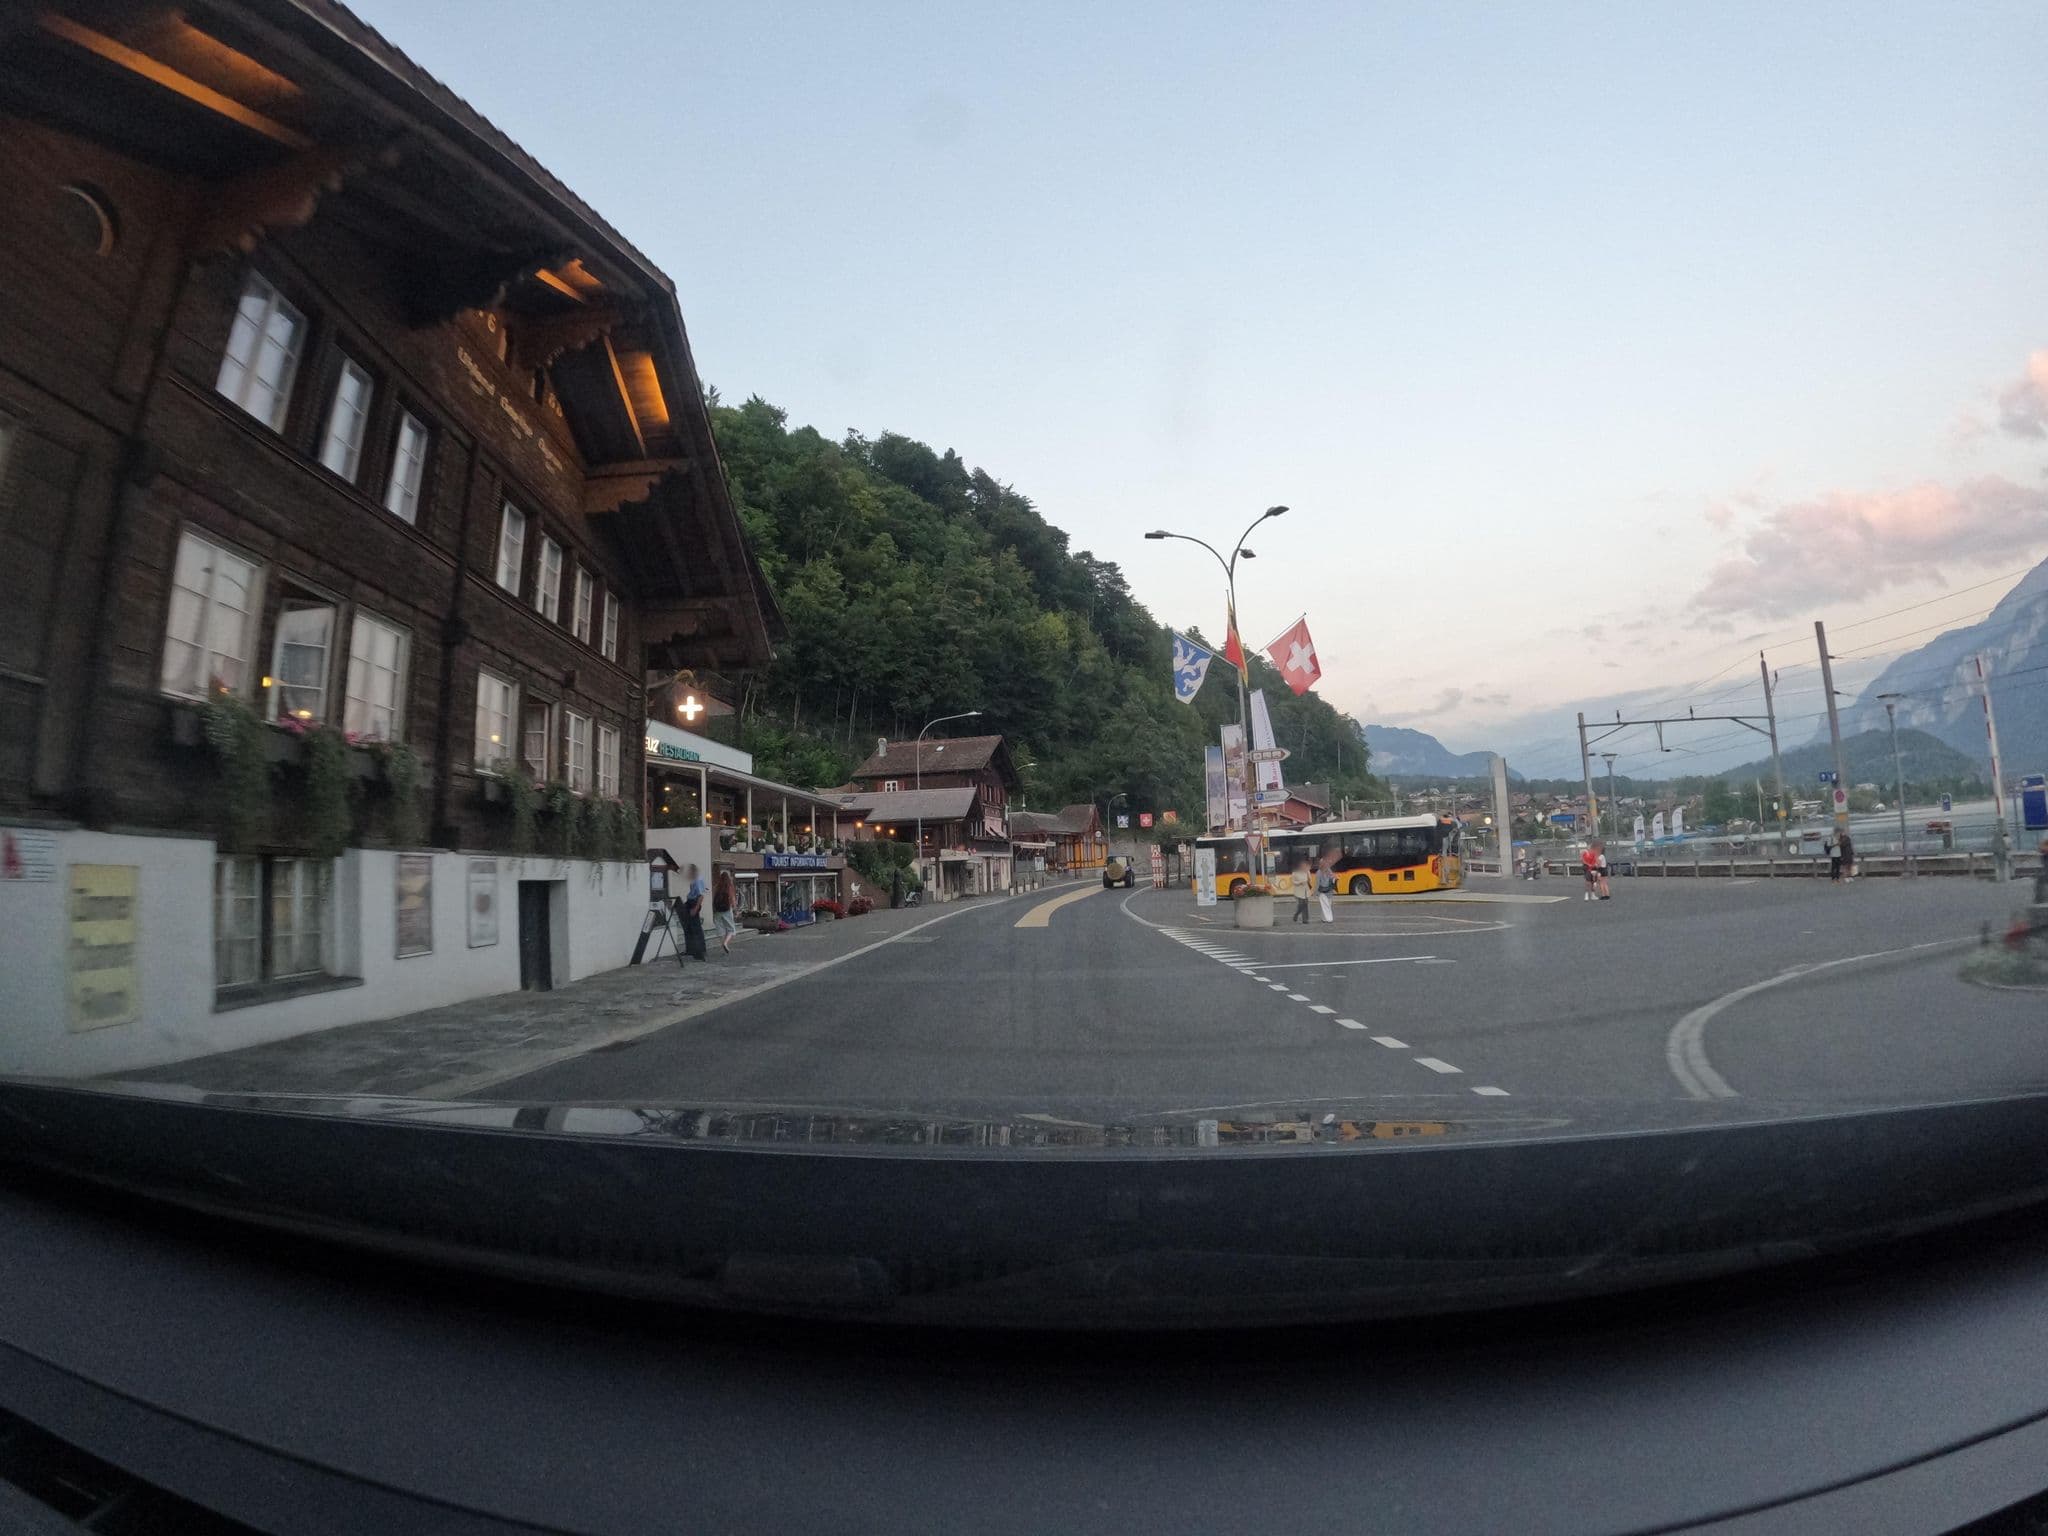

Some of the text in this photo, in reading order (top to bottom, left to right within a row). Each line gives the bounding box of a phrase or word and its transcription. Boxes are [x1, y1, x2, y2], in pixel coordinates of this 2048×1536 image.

[660, 743, 700, 762] RESTAURANT
[771, 856, 789, 867] TOURIST
[790, 857, 815, 867] INFORMATION
